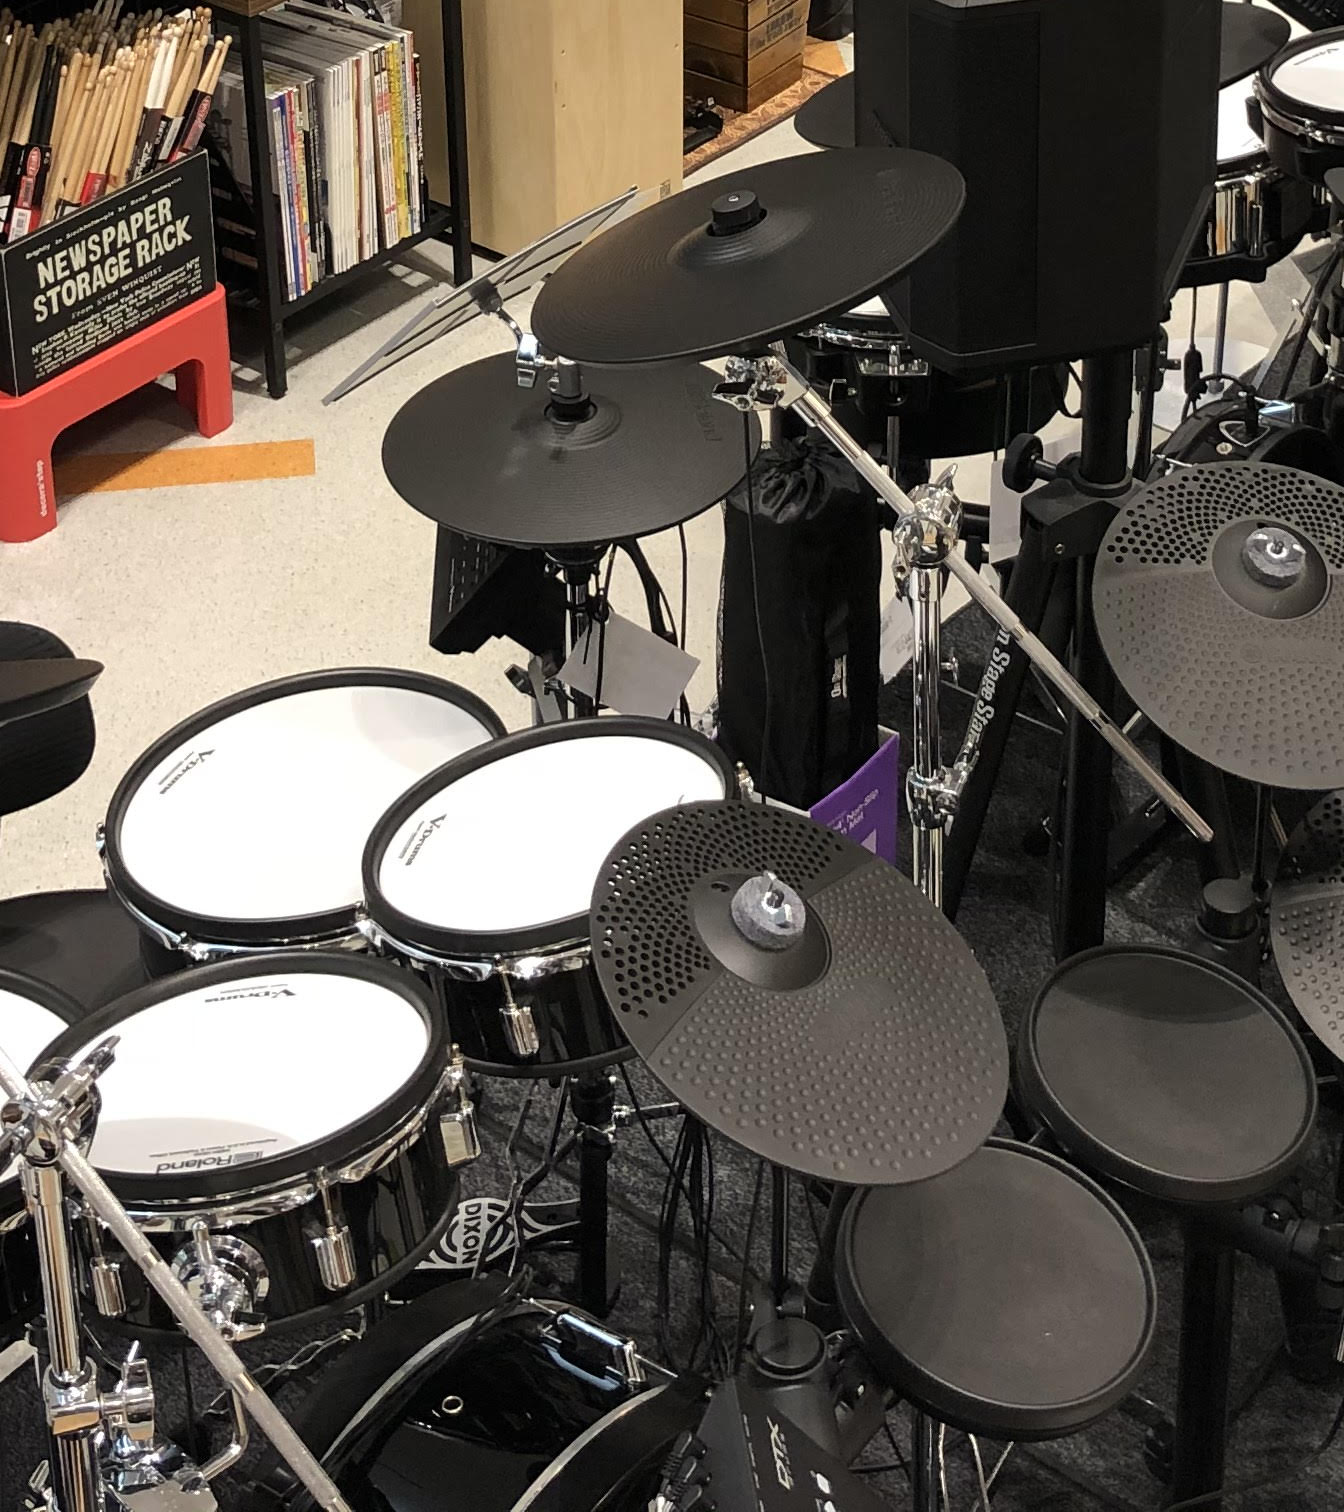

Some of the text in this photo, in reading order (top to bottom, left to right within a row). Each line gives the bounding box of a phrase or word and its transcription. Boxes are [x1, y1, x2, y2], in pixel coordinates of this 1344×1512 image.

[33, 250, 131, 323] STORAGE
[136, 214, 193, 269] RACK
[36, 196, 173, 289] NEWSPAPER
[72, 265, 163, 320] From SVEN WINQUIST
[984, 646, 1012, 701] Stage
[159, 748, 216, 795] V-Drums
[405, 813, 448, 867] V-Drums
[204, 988, 298, 1005] V-Drums
[156, 1149, 233, 1173] Roland
[463, 1202, 483, 1266] DIXON
[766, 1416, 794, 1492] DTX
